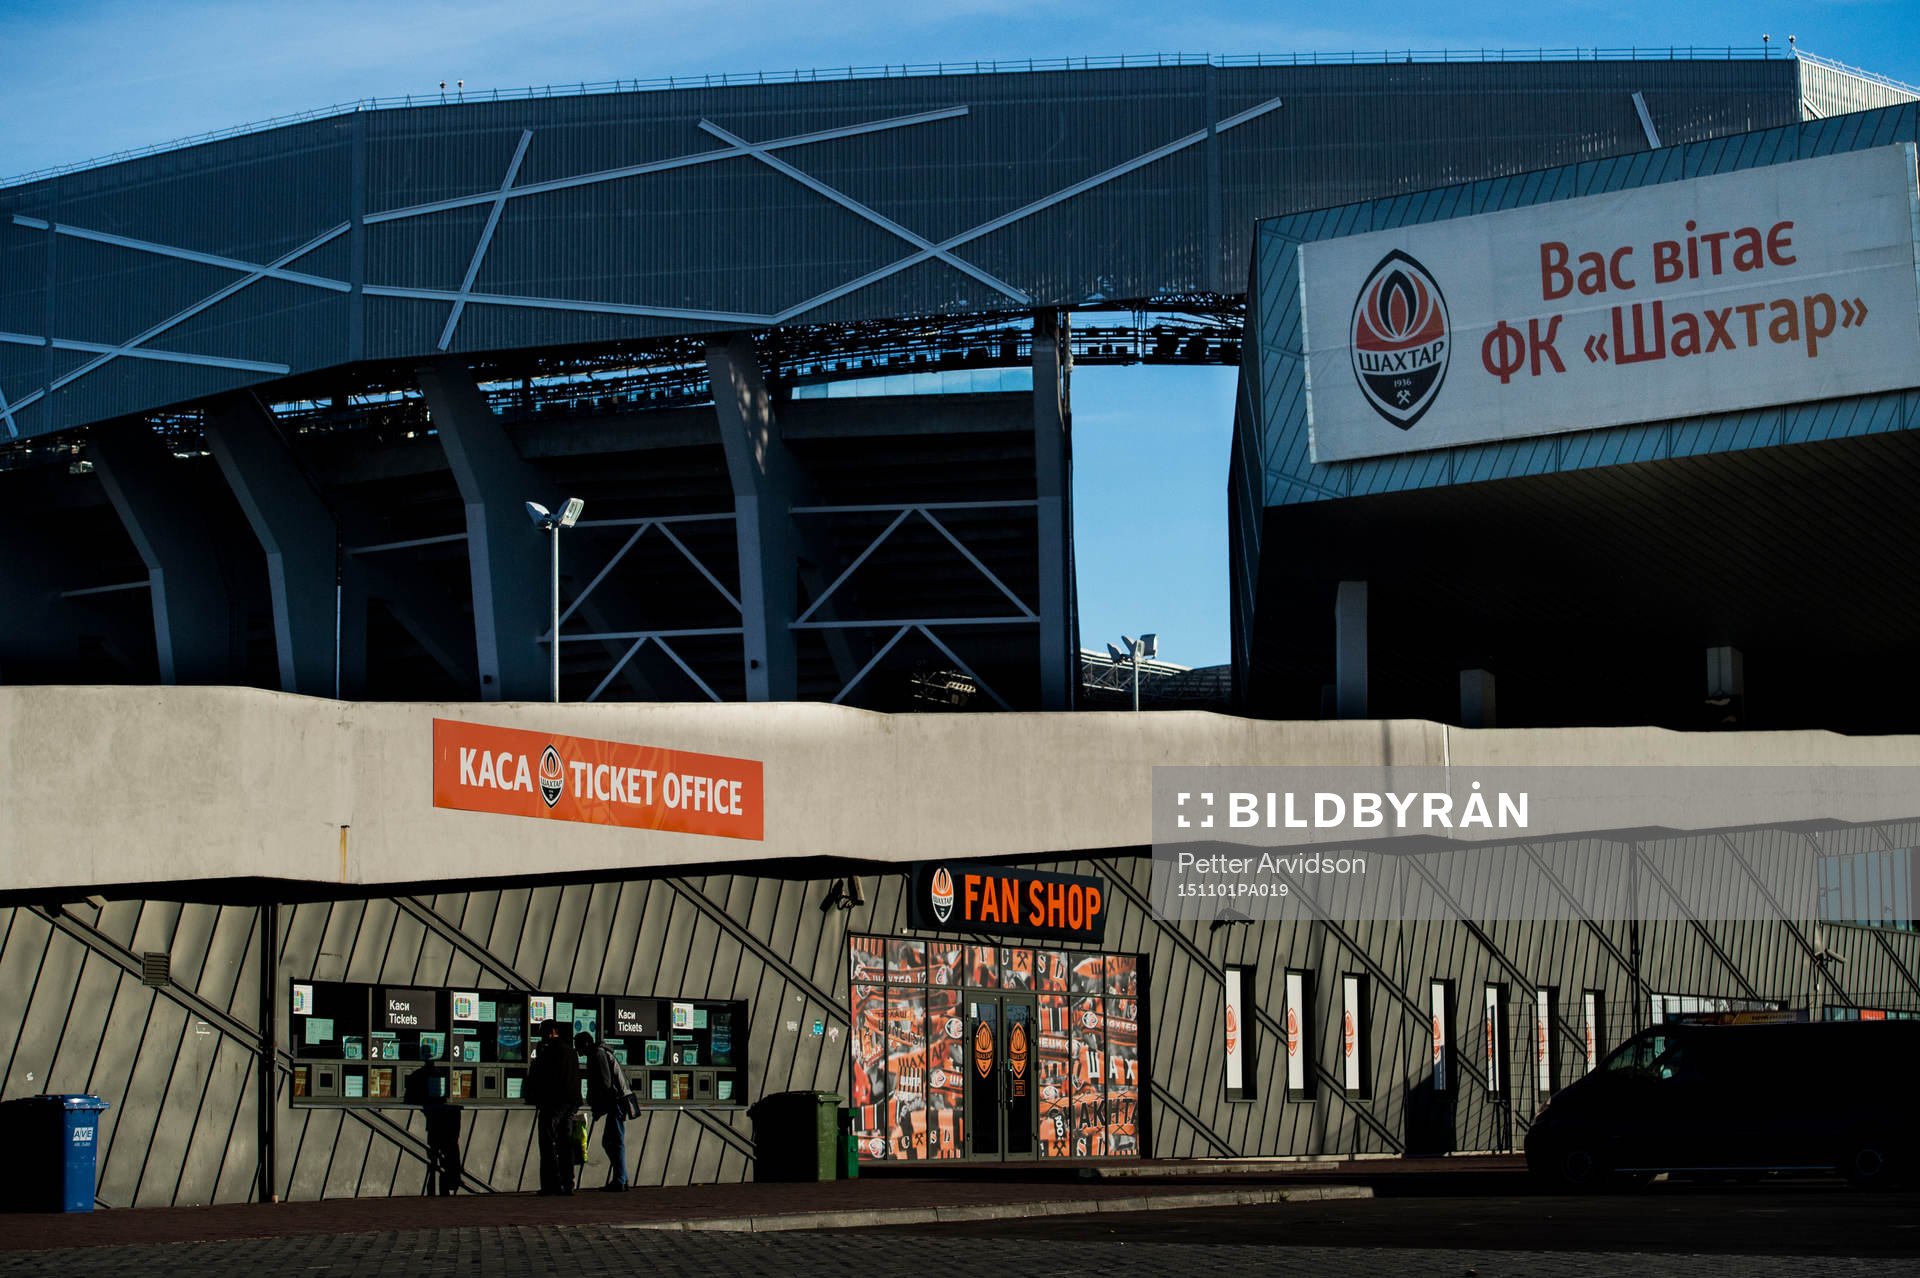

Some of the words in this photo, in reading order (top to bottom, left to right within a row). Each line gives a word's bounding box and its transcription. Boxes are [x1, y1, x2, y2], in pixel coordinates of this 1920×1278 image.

[1540, 240, 1636, 302] Вас
[1653, 219, 1797, 286] вітає
[1481, 314, 1566, 385] ФК
[1583, 291, 1869, 366] «Шахтар»
[1358, 340, 1444, 372] ШАХТАР
[1393, 377, 1412, 388] 1936
[569, 760, 657, 806] TICKET
[662, 772, 743, 816] OFFICE
[964, 873, 1020, 925] FAN
[1028, 879, 1101, 931] SHOP
[389, 999, 410, 1011] Каси
[389, 1013, 418, 1025] Tickets
[618, 1009, 636, 1020] Каси
[618, 1021, 643, 1033] Tickets
[371, 1047, 378, 1058] 2
[453, 1046, 460, 1057] 3
[530, 1049, 537, 1059] 4
[673, 1053, 679, 1063] 6
[74, 1129, 92, 1138] AVE
